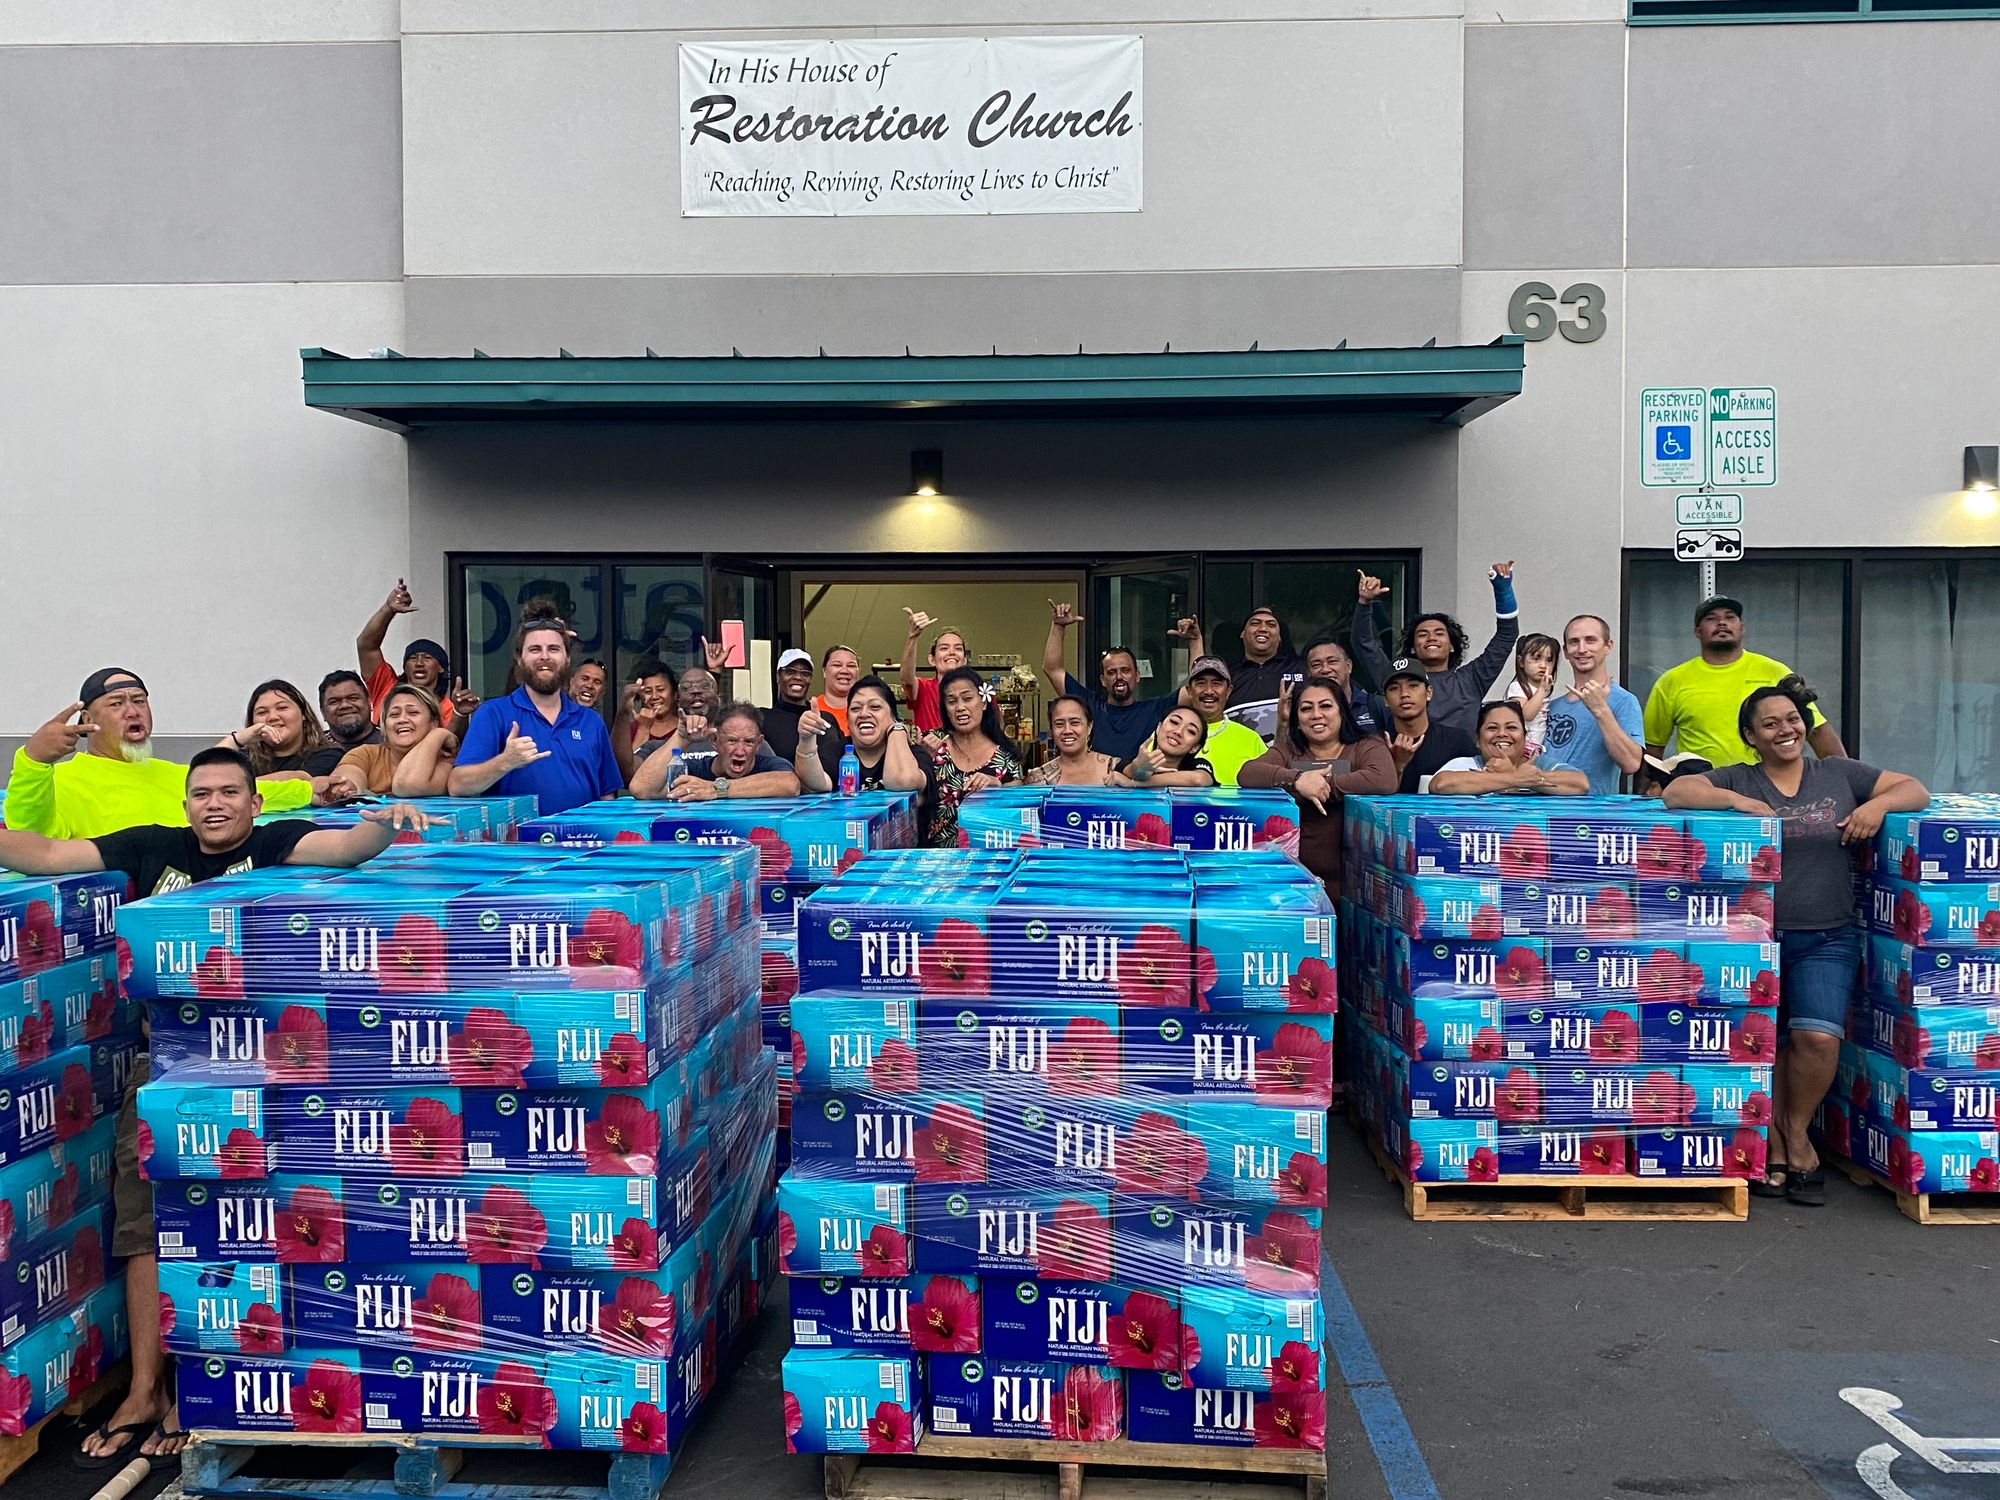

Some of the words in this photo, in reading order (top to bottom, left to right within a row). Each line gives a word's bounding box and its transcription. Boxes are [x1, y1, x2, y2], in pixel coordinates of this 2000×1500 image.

[708, 58, 730, 85] In
[739, 57, 779, 84] His
[787, 56, 858, 85] House
[866, 52, 898, 93] of
[689, 94, 950, 146] Restoration
[966, 89, 1134, 148] Church
[802, 169, 883, 203] Reviving,
[889, 169, 976, 201] Restoring
[980, 168, 1025, 191] Lives
[1030, 168, 1048, 189] to
[1508, 281, 1607, 344] 63
[1644, 393, 1703, 407] RESERVED
[1649, 410, 1699, 422] PARKING
[1711, 395, 1729, 414] NO
[1731, 398, 1772, 410] PARKING
[1715, 430, 1771, 448] ACCESS
[1722, 456, 1765, 474] AISLE
[1696, 500, 1723, 510] VAN
[842, 766, 855, 777] FIJI
[1087, 821, 1126, 849] FIJI
[1214, 822, 1254, 850] FIJI
[1459, 832, 1501, 863] FIJI
[1596, 834, 1638, 864] FIJI
[1888, 837, 1903, 862] FIJI
[808, 844, 838, 868] FIJI
[1722, 842, 1752, 864] FIJI
[1964, 837, 2000, 869] FIJ
[1442, 900, 1472, 922] FIJI
[1546, 894, 1587, 925] FIJI
[1687, 896, 1728, 926] FIJI
[1874, 890, 1895, 925] FIJI
[1948, 906, 1979, 928] FIJI
[0, 916, 19, 962] JI
[318, 928, 380, 971] FIJI
[508, 923, 570, 968] FIJI
[860, 932, 921, 977] FIJI
[155, 941, 198, 973] FIJI
[1057, 935, 1120, 982] FIJI
[1242, 952, 1290, 986] FIJI
[1455, 953, 1496, 985] FIJI
[1597, 957, 1638, 988] FIJI
[1720, 966, 1750, 988] FIJI
[65, 992, 87, 1027] FIJI
[0, 1016, 18, 1050] IJI
[209, 1017, 266, 1060] FIJI
[390, 1020, 451, 1065] FIJI
[1443, 1023, 1473, 1045] FIJI
[1550, 1018, 1590, 1049] FIJI
[1689, 1020, 1730, 1051] FIJI
[1874, 1009, 1894, 1045] FIJI
[1948, 1031, 1977, 1053] FIJI
[556, 1028, 602, 1062] FIJI
[829, 1034, 874, 1067] FIJI
[987, 1026, 1049, 1072] FIJI
[1193, 1034, 1257, 1081] FIJI
[1454, 1076, 1496, 1108] FIJI
[1592, 1078, 1633, 1109] FIJI
[1712, 1087, 1742, 1110] FIJI
[1953, 1087, 1996, 1118] FIJI
[17, 1084, 56, 1139] FIJI
[176, 1124, 221, 1155] FIJI
[333, 1110, 392, 1154] FIJI
[526, 1107, 587, 1152] FIJI
[855, 1114, 915, 1159] FIJI
[1054, 1122, 1117, 1169] FIJI
[1233, 1145, 1280, 1180] FIJI
[1439, 1144, 1469, 1166] FIJI
[1540, 1132, 1581, 1162] FIJI
[1682, 1136, 1724, 1167] FIJI
[1868, 1128, 1889, 1166] FIJI
[1941, 1155, 1971, 1176] FIJI
[26, 1181, 49, 1222] FIJI
[675, 1169, 695, 1228] FIJI
[216, 1198, 277, 1241] FIJI
[408, 1198, 468, 1242] FIJI
[570, 1213, 615, 1246] FIJI
[819, 1218, 863, 1251] FIJI
[978, 1209, 1039, 1256] FIJI
[1183, 1220, 1246, 1267] FIJI
[35, 1250, 68, 1309] FIJI
[197, 1298, 241, 1330] FIJI
[355, 1284, 413, 1328] FIJI
[542, 1288, 601, 1334] FIJI
[850, 1287, 910, 1333] FIJI
[1048, 1298, 1109, 1345] FIJI
[1226, 1333, 1273, 1367] FIJI
[45, 1350, 70, 1394] FIJI
[685, 1343, 702, 1404] FIJI
[234, 1371, 294, 1414] FIJI
[421, 1371, 480, 1418] FIJI
[992, 1376, 1053, 1423] FIJI
[579, 1395, 623, 1428] FIJI
[824, 1396, 869, 1429] FIJI
[1193, 1389, 1255, 1431] FIJI
